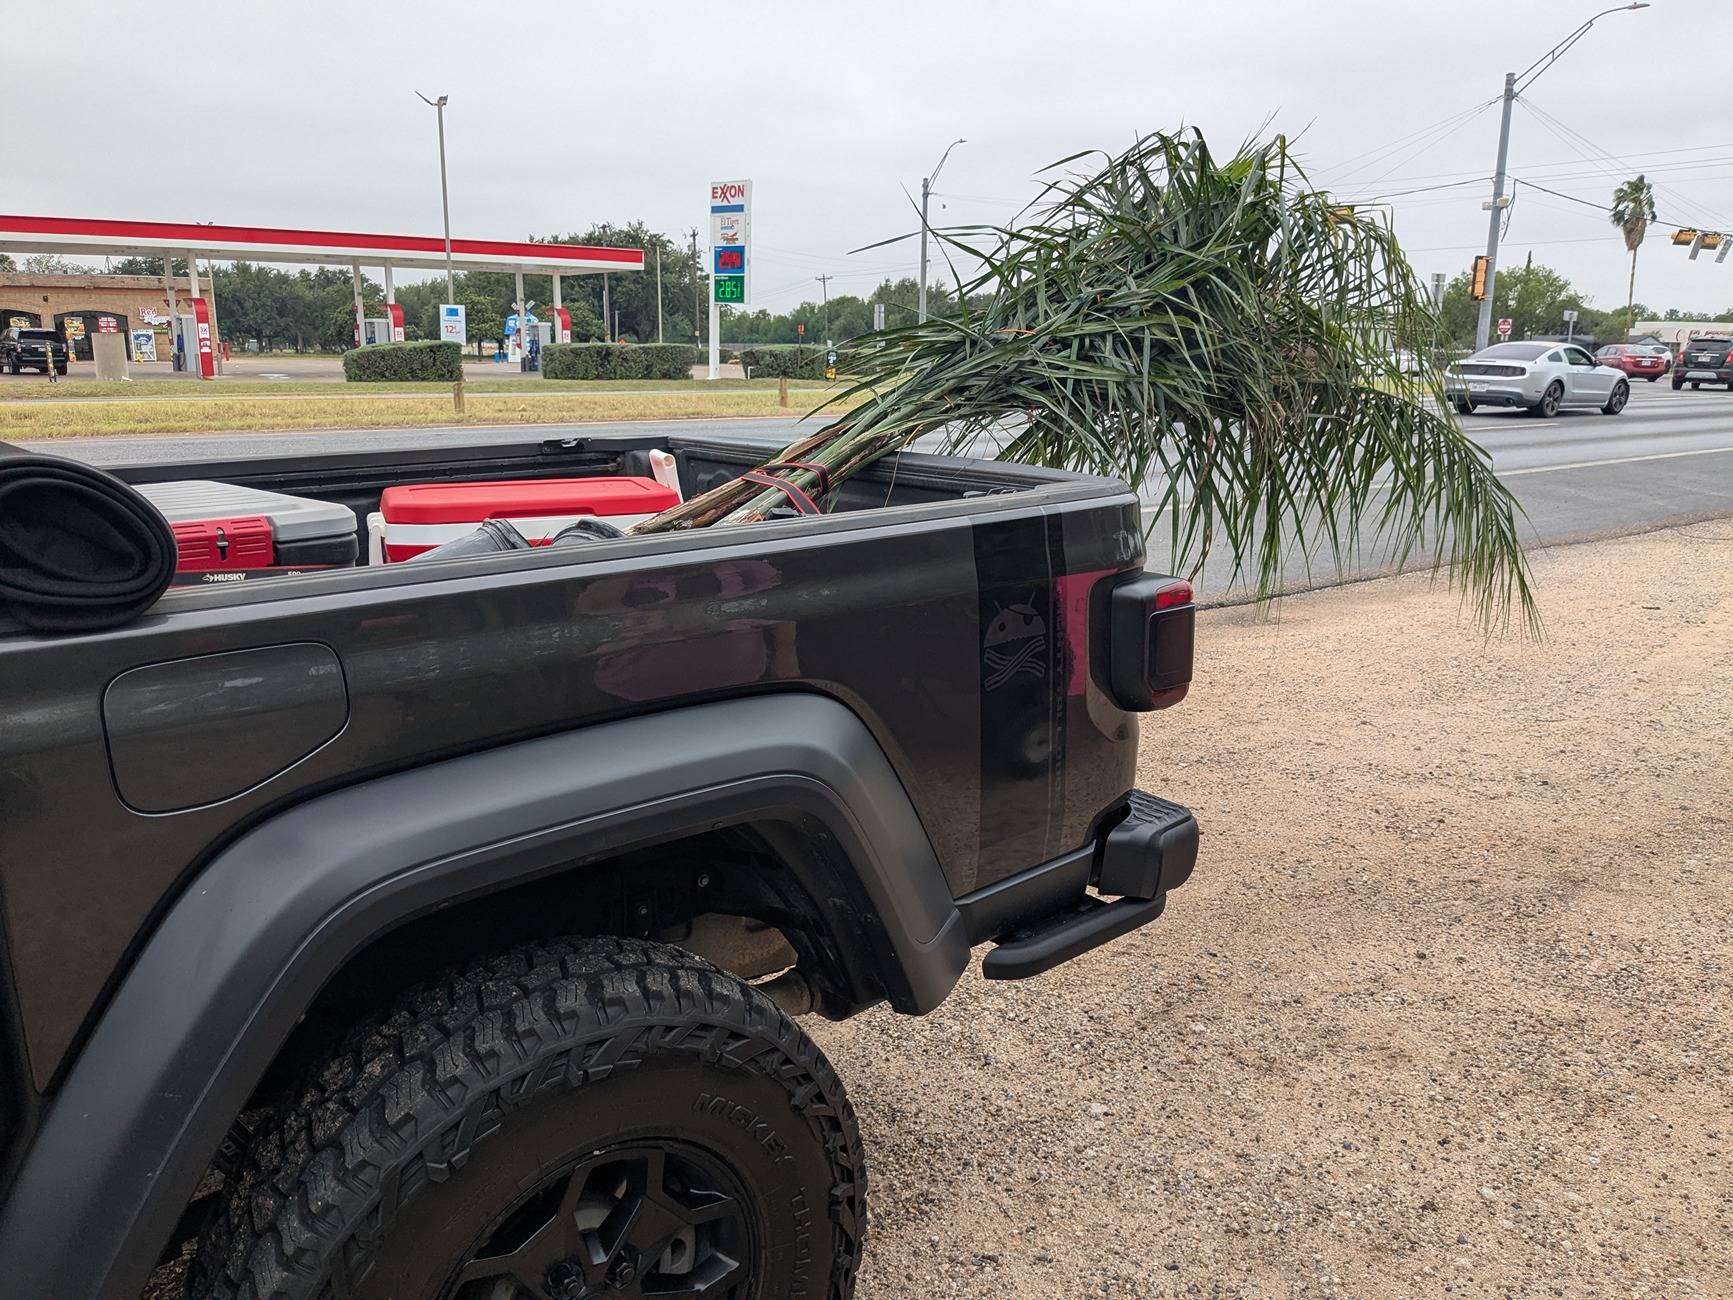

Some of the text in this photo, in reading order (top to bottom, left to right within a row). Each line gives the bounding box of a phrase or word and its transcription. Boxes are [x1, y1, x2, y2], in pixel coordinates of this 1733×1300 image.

[712, 184, 744, 203] EXXON
[213, 573, 246, 582] HUSKY
[691, 1092, 794, 1163] MICKEY
